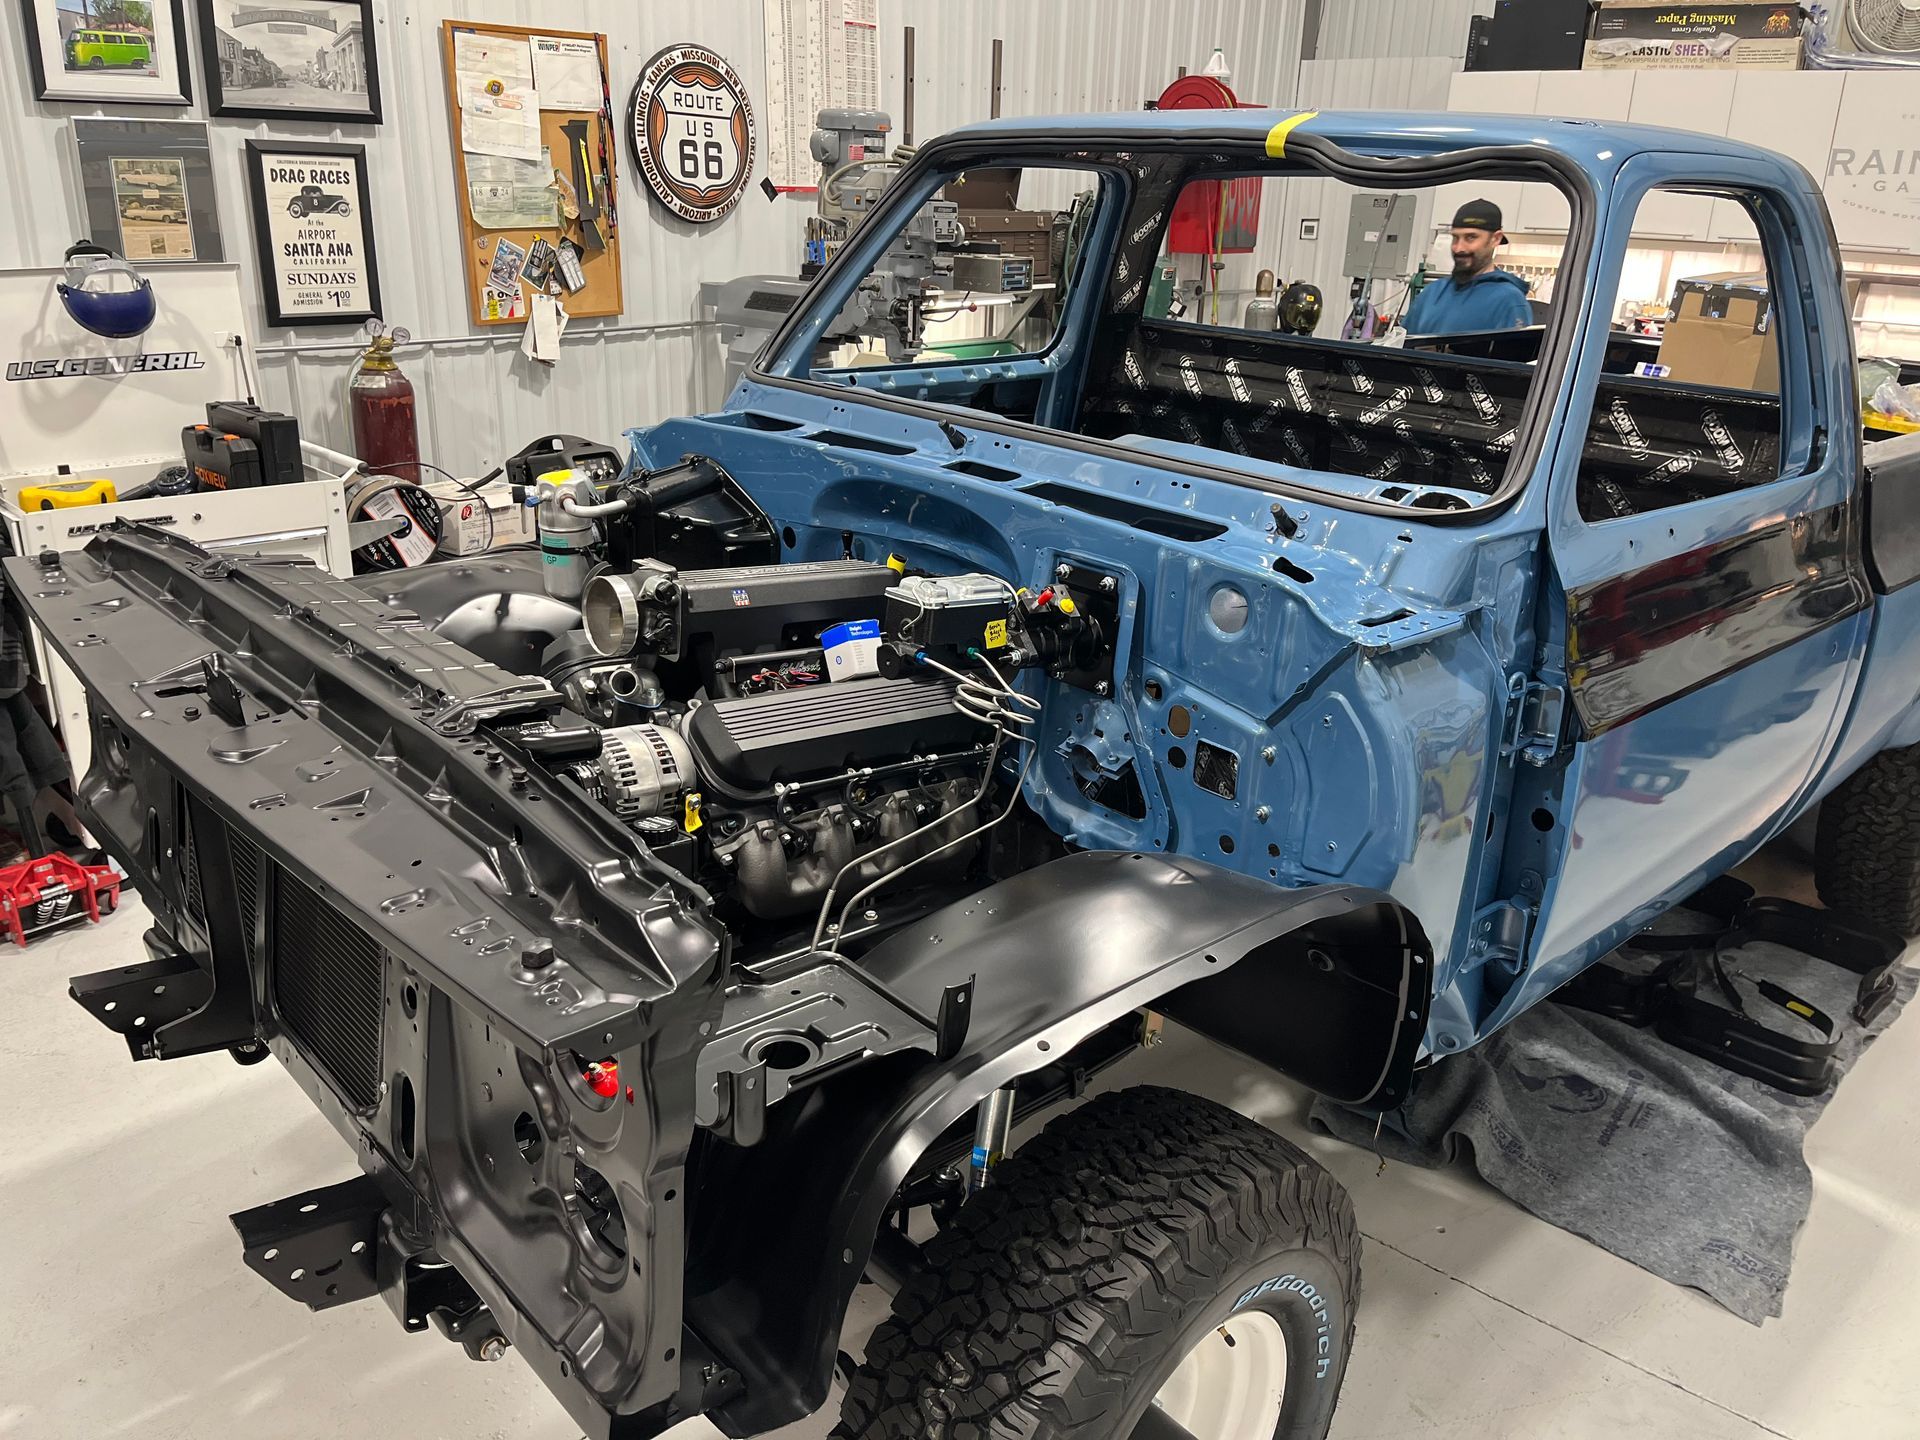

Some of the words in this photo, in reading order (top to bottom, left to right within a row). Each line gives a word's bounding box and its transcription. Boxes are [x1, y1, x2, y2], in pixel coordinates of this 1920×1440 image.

[1655, 14, 1687, 25] Paper
[1689, 14, 1737, 25] Masking
[1625, 45, 1671, 56] LASTIC
[680, 50, 720, 70] MISSOURI
[647, 54, 677, 87] KANSAS
[673, 92, 723, 111] ROUTE
[724, 68, 740, 88] NEW
[738, 88, 754, 128] MEXICO
[636, 90, 650, 138] ILLINOIS
[679, 139, 723, 180] 66
[738, 136, 756, 194] OKLAHOMA
[270, 168, 306, 183] DRAG
[310, 169, 350, 184] RACES
[640, 146, 674, 206] CALIFORNIA
[678, 204, 713, 221] ARIZONA
[717, 195, 738, 217] TEXAS
[1842, 200, 1886, 215] CUSTOM
[307, 219, 314, 227] At
[316, 219, 324, 227] the
[298, 229, 336, 240] AIRPORT
[284, 243, 324, 257] SANTA
[328, 243, 353, 257] ANA
[293, 258, 347, 266] CALIFORNIA
[287, 273, 356, 285] SUNDAYS
[297, 291, 323, 299] GENERAL
[1287, 368, 1304, 396] BOOM
[546, 556, 557, 564] GP
[849, 625, 862, 633] Delphi
[851, 629, 873, 637] Technologies
[1634, 1101, 1656, 1129] U-HAUL
[1706, 1242, 1737, 1254] NOT
[1742, 1253, 1758, 1267] TO
[1231, 1274, 1331, 1379] BFGoodrich
